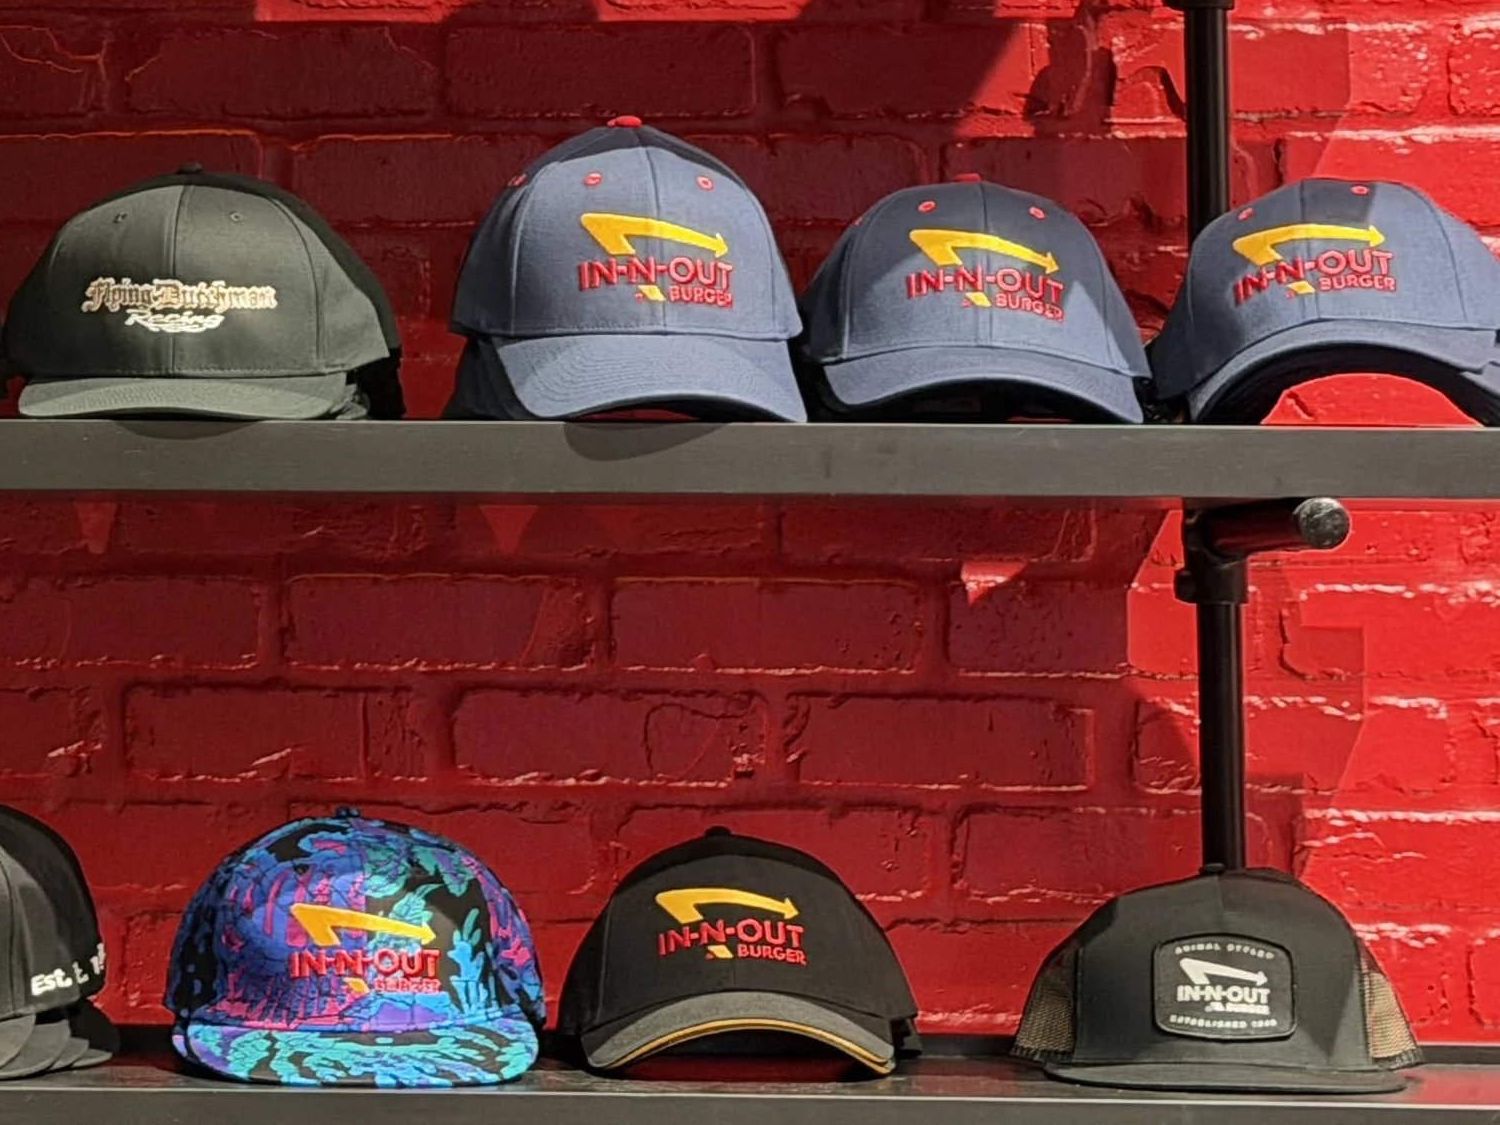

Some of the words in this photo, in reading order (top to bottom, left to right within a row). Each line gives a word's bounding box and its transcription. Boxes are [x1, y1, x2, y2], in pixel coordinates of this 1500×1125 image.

[578, 255, 734, 292] IN-N-OUT
[906, 263, 1064, 303] IN-N-OUT
[1232, 248, 1394, 307] IN-N-OUT
[1318, 274, 1397, 293] BURGER
[81, 276, 154, 312] Flying
[153, 278, 278, 313] Dutchman
[668, 284, 734, 308] BURGER
[995, 292, 1064, 322] BURGER
[658, 917, 805, 956] IN-N-OUT
[290, 947, 442, 980] IN-N-OUT
[736, 943, 808, 966] BURGER
[1176, 984, 1271, 1004] IN-N-OUT
